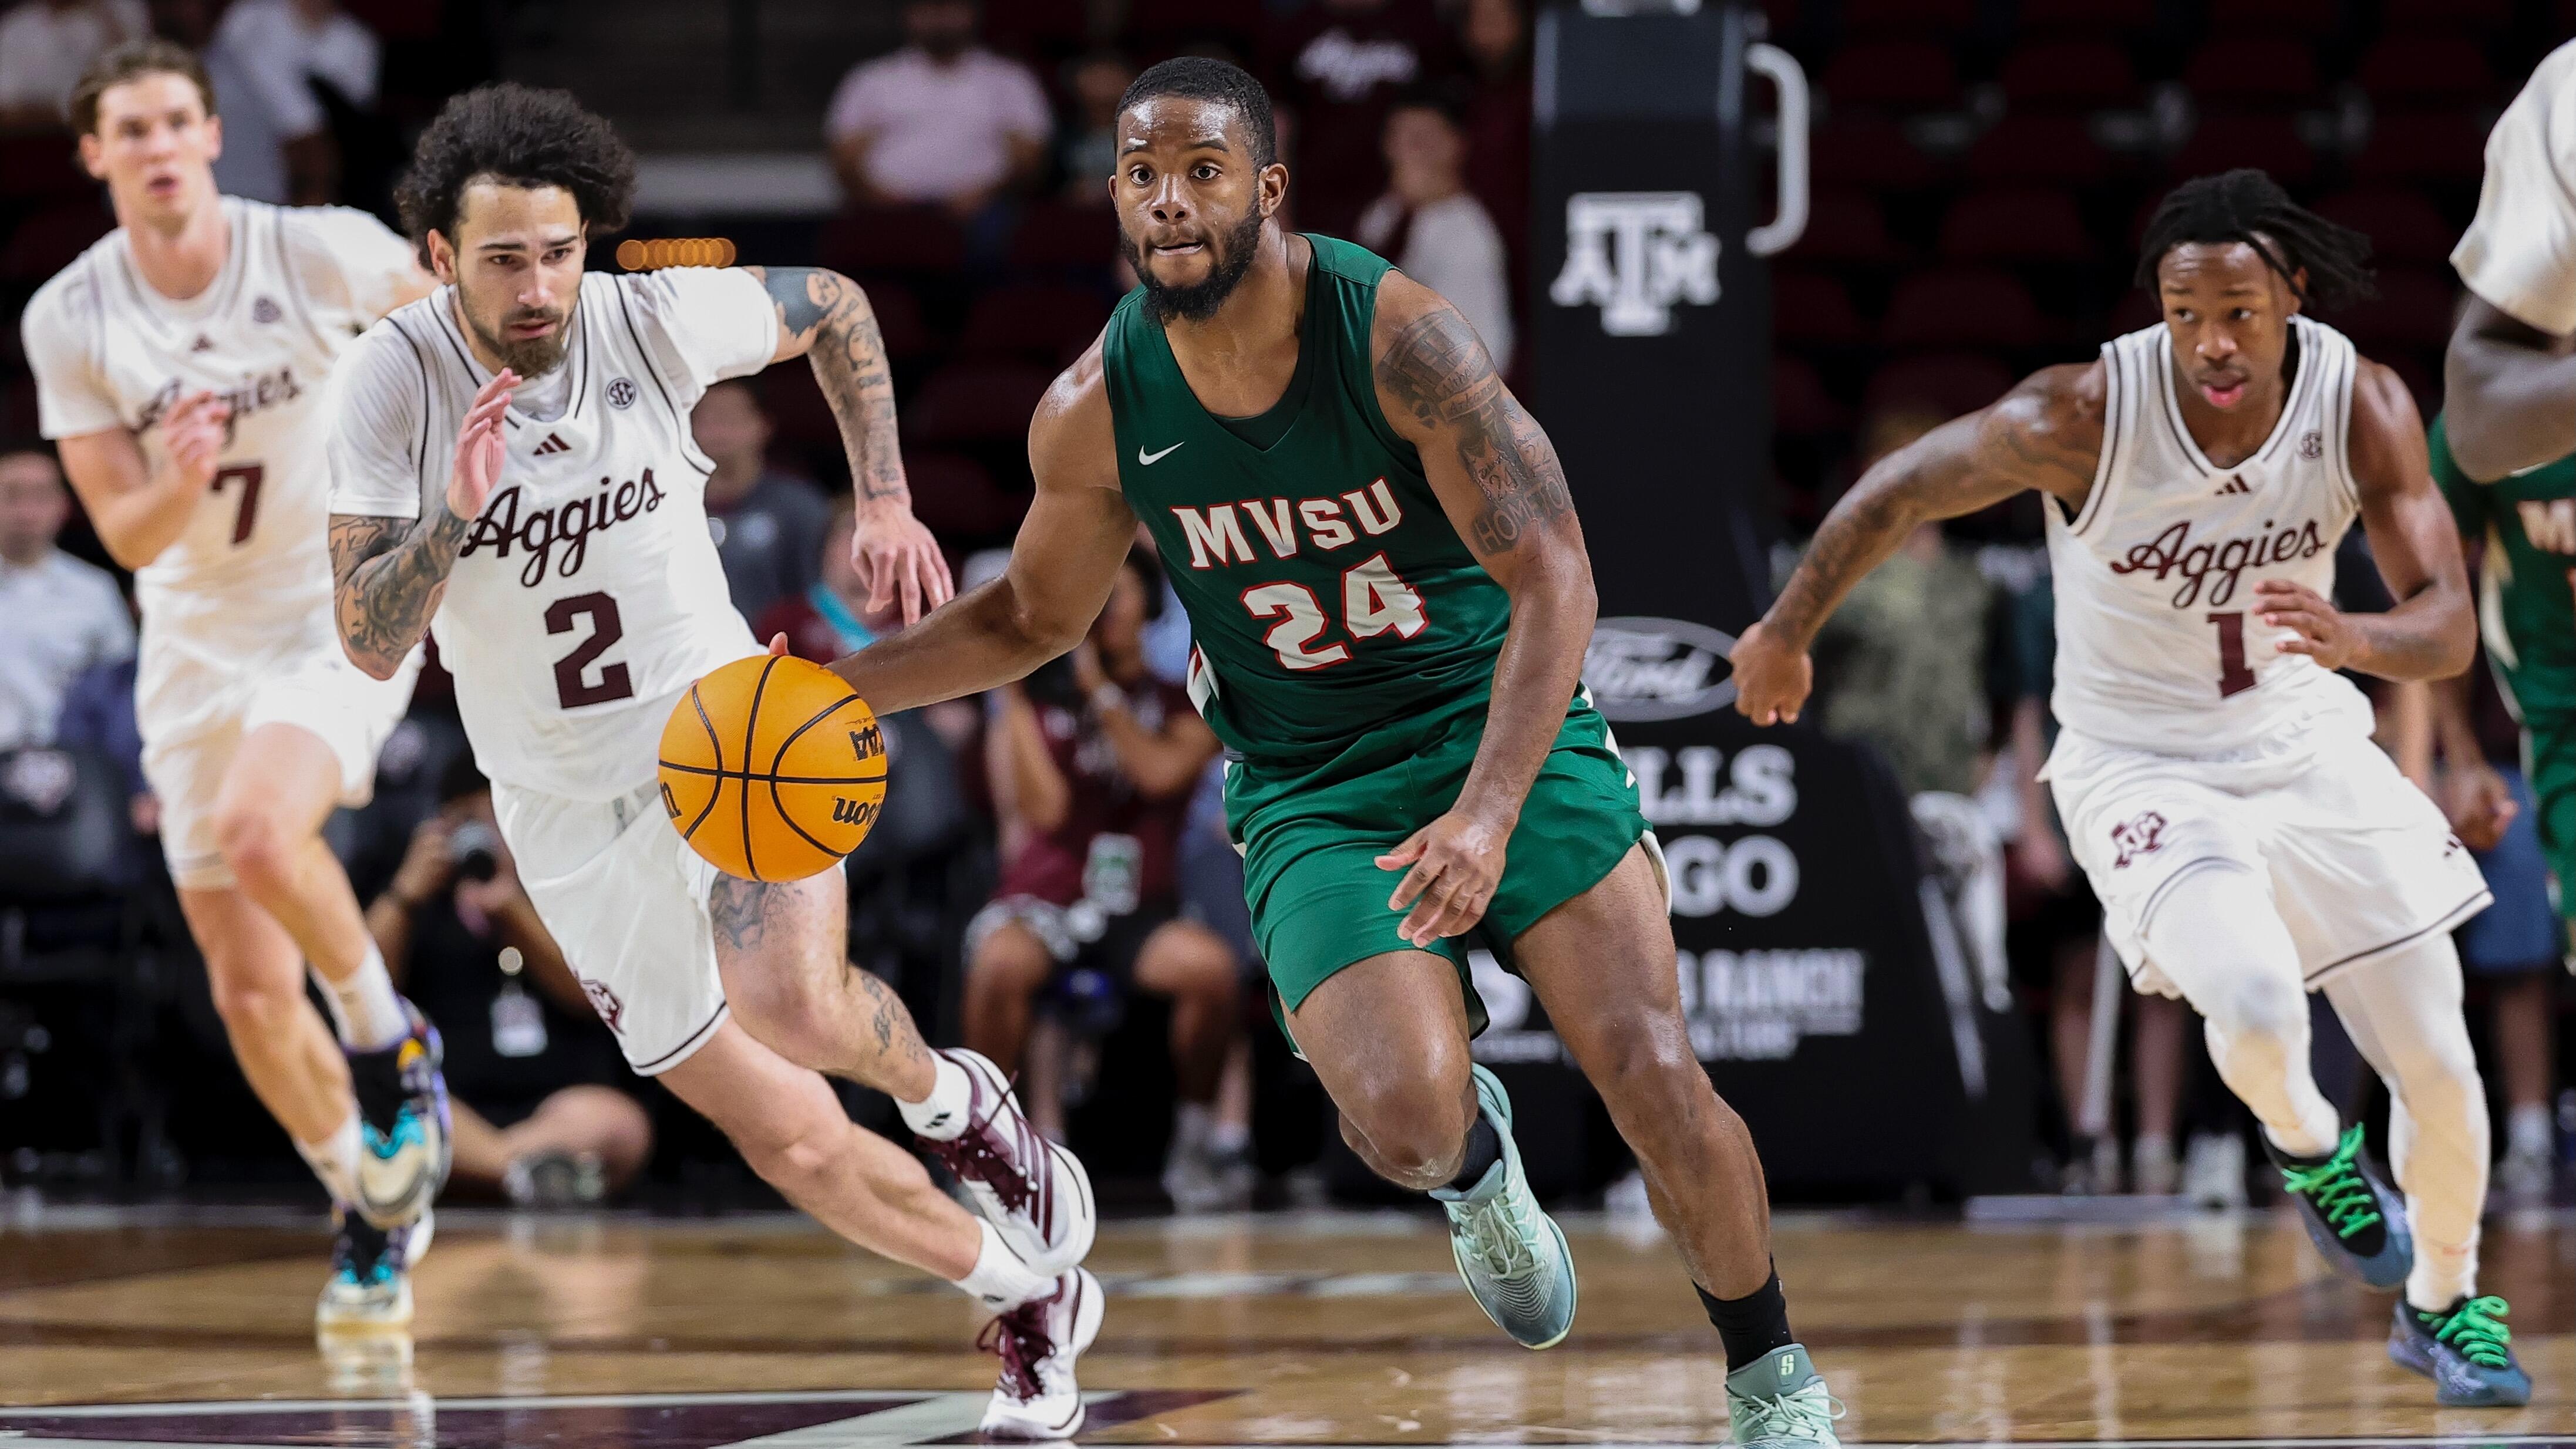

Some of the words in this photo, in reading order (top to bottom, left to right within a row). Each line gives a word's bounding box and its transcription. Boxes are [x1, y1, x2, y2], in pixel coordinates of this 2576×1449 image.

[210, 460, 265, 547] 7
[460, 467, 666, 588] Aggies
[1169, 476, 1403, 570] MVSU
[1240, 550, 1430, 670] 24
[2110, 519, 2329, 609] Aggies
[544, 591, 634, 709] 2
[2207, 612, 2256, 699] 1
[1619, 744, 1798, 827] LLS
